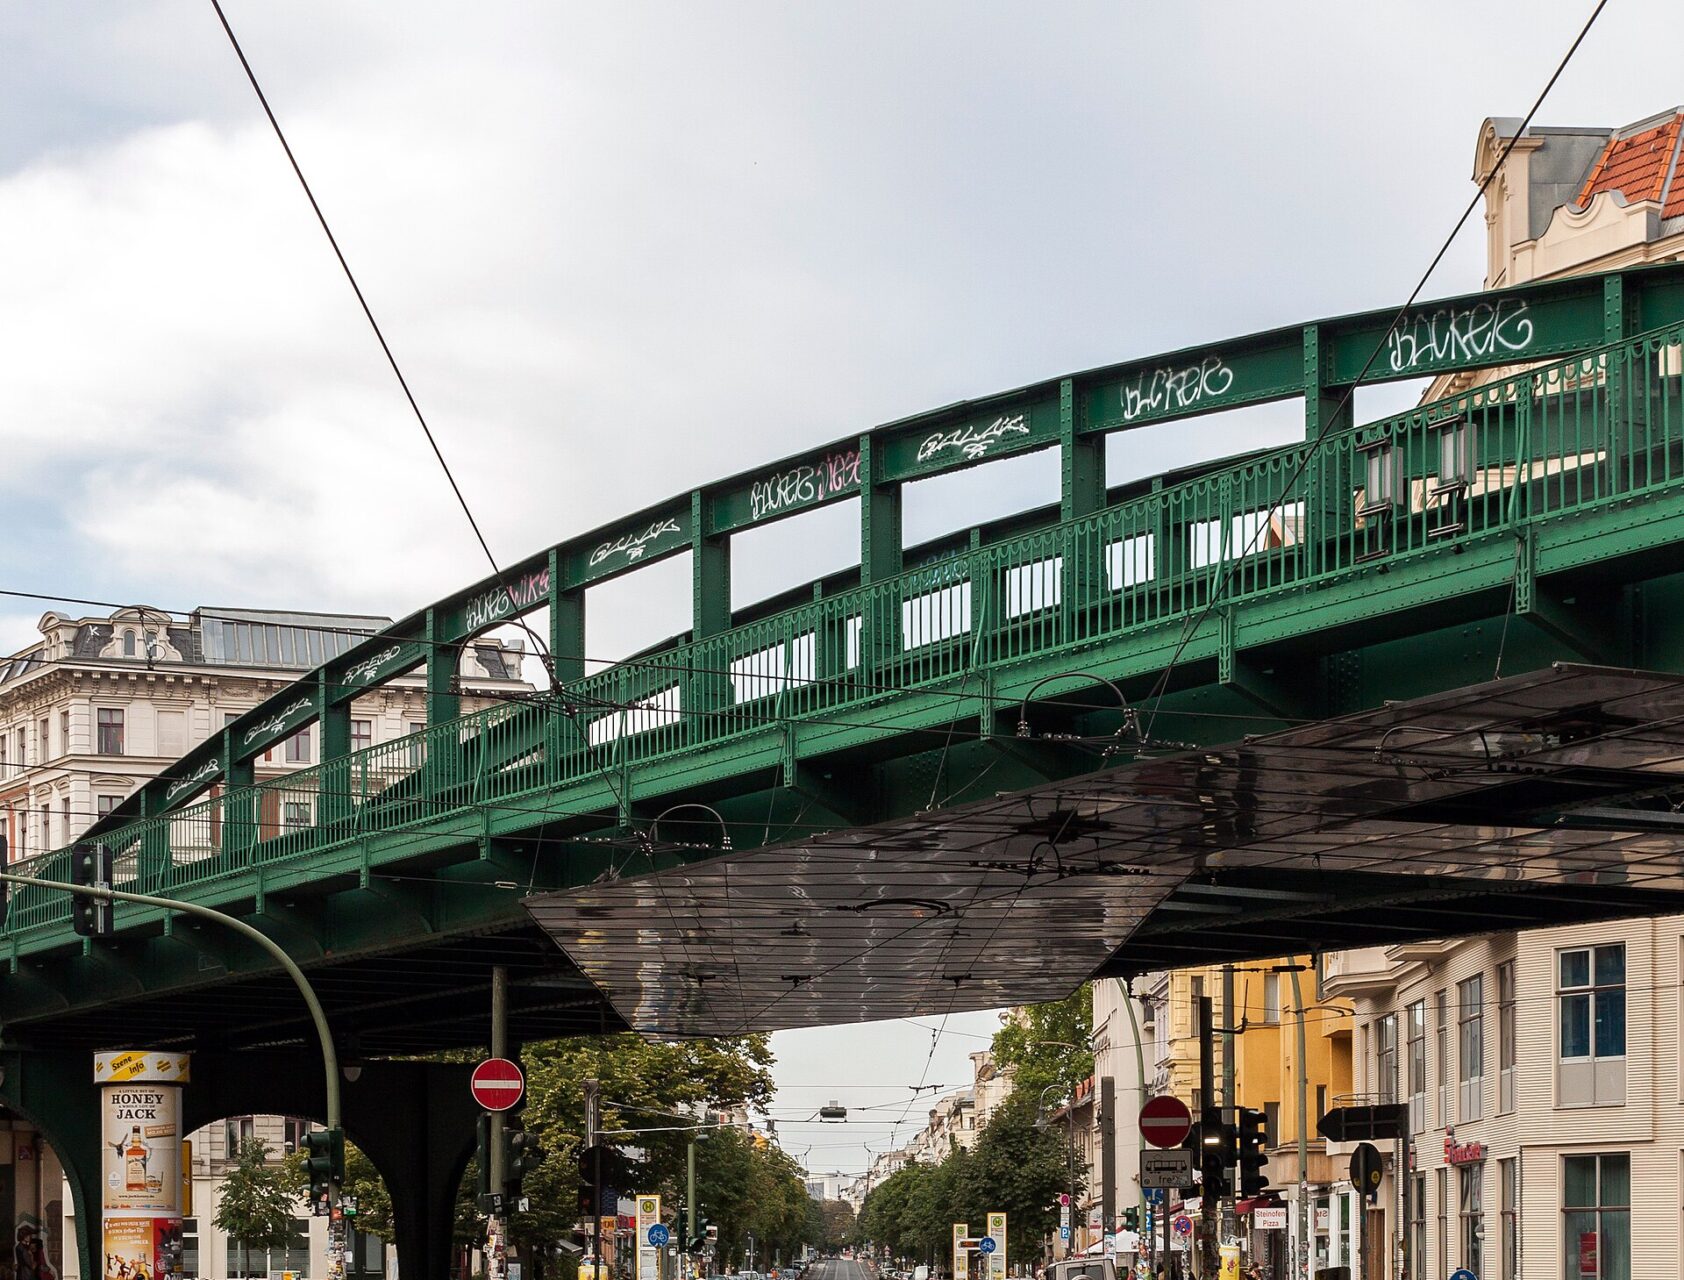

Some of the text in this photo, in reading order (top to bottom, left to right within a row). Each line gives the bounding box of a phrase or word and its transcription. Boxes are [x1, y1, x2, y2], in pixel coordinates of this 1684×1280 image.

[112, 1056, 133, 1072] Szene
[129, 1062, 145, 1074] Info
[111, 1093, 164, 1104] HONEY
[117, 1109, 156, 1119] JACK
[1255, 1210, 1286, 1218] Steinofen
[1262, 1219, 1280, 1227] Pizza
